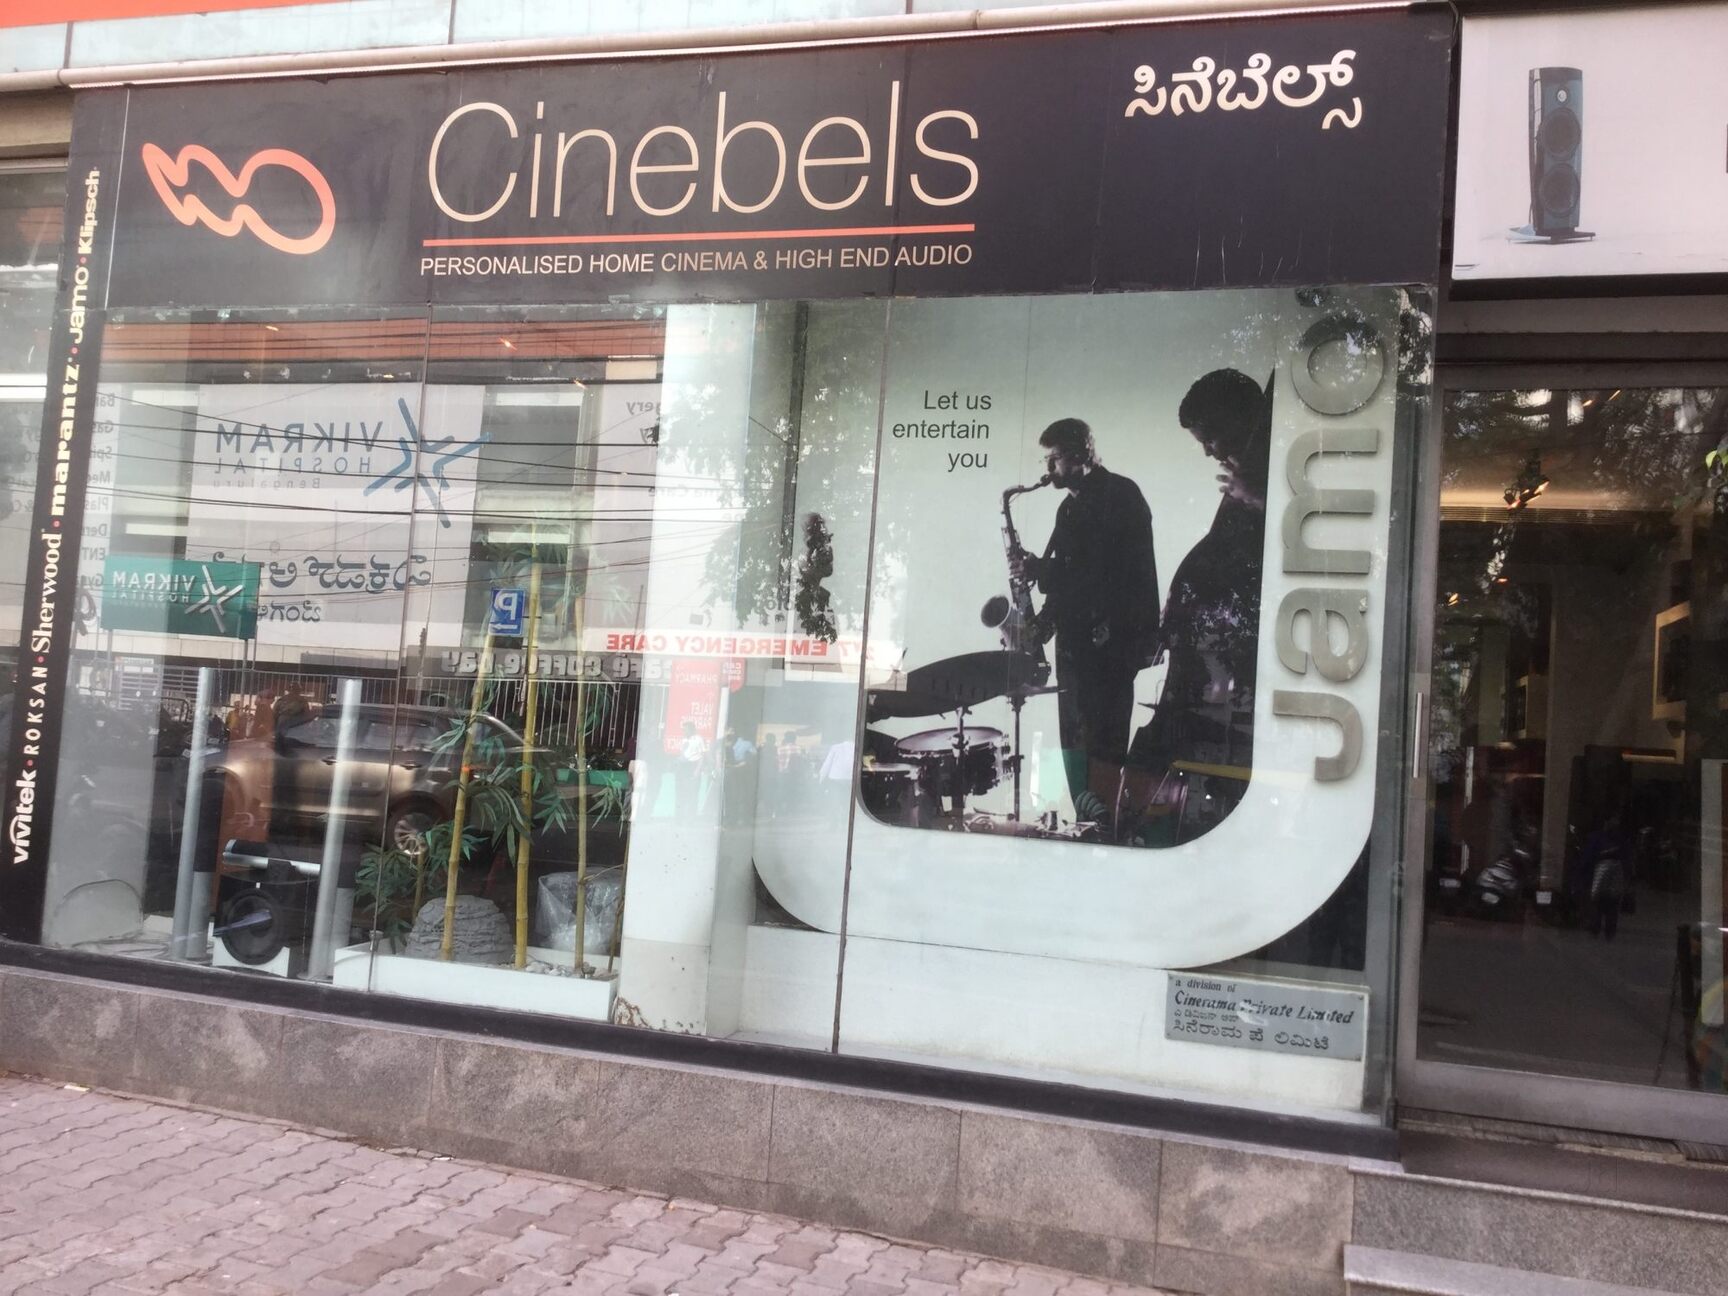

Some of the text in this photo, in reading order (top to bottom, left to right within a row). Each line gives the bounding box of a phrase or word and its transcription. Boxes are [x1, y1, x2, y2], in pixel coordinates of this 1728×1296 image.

[428, 80, 979, 223] Cinebels
[420, 244, 973, 276] PERSONALISED HOME CINEMA & HIGH END AUDIO
[924, 390, 992, 410] Let us
[893, 419, 989, 439] entertain
[948, 453, 988, 473] you
[9, 170, 100, 864] vivitek ROKSAN Sherwood marantz Jamo Klipsch
[1272, 314, 1384, 782] Jamo
[1187, 978, 1222, 992] division
[1174, 989, 1236, 1012] Cinerama
